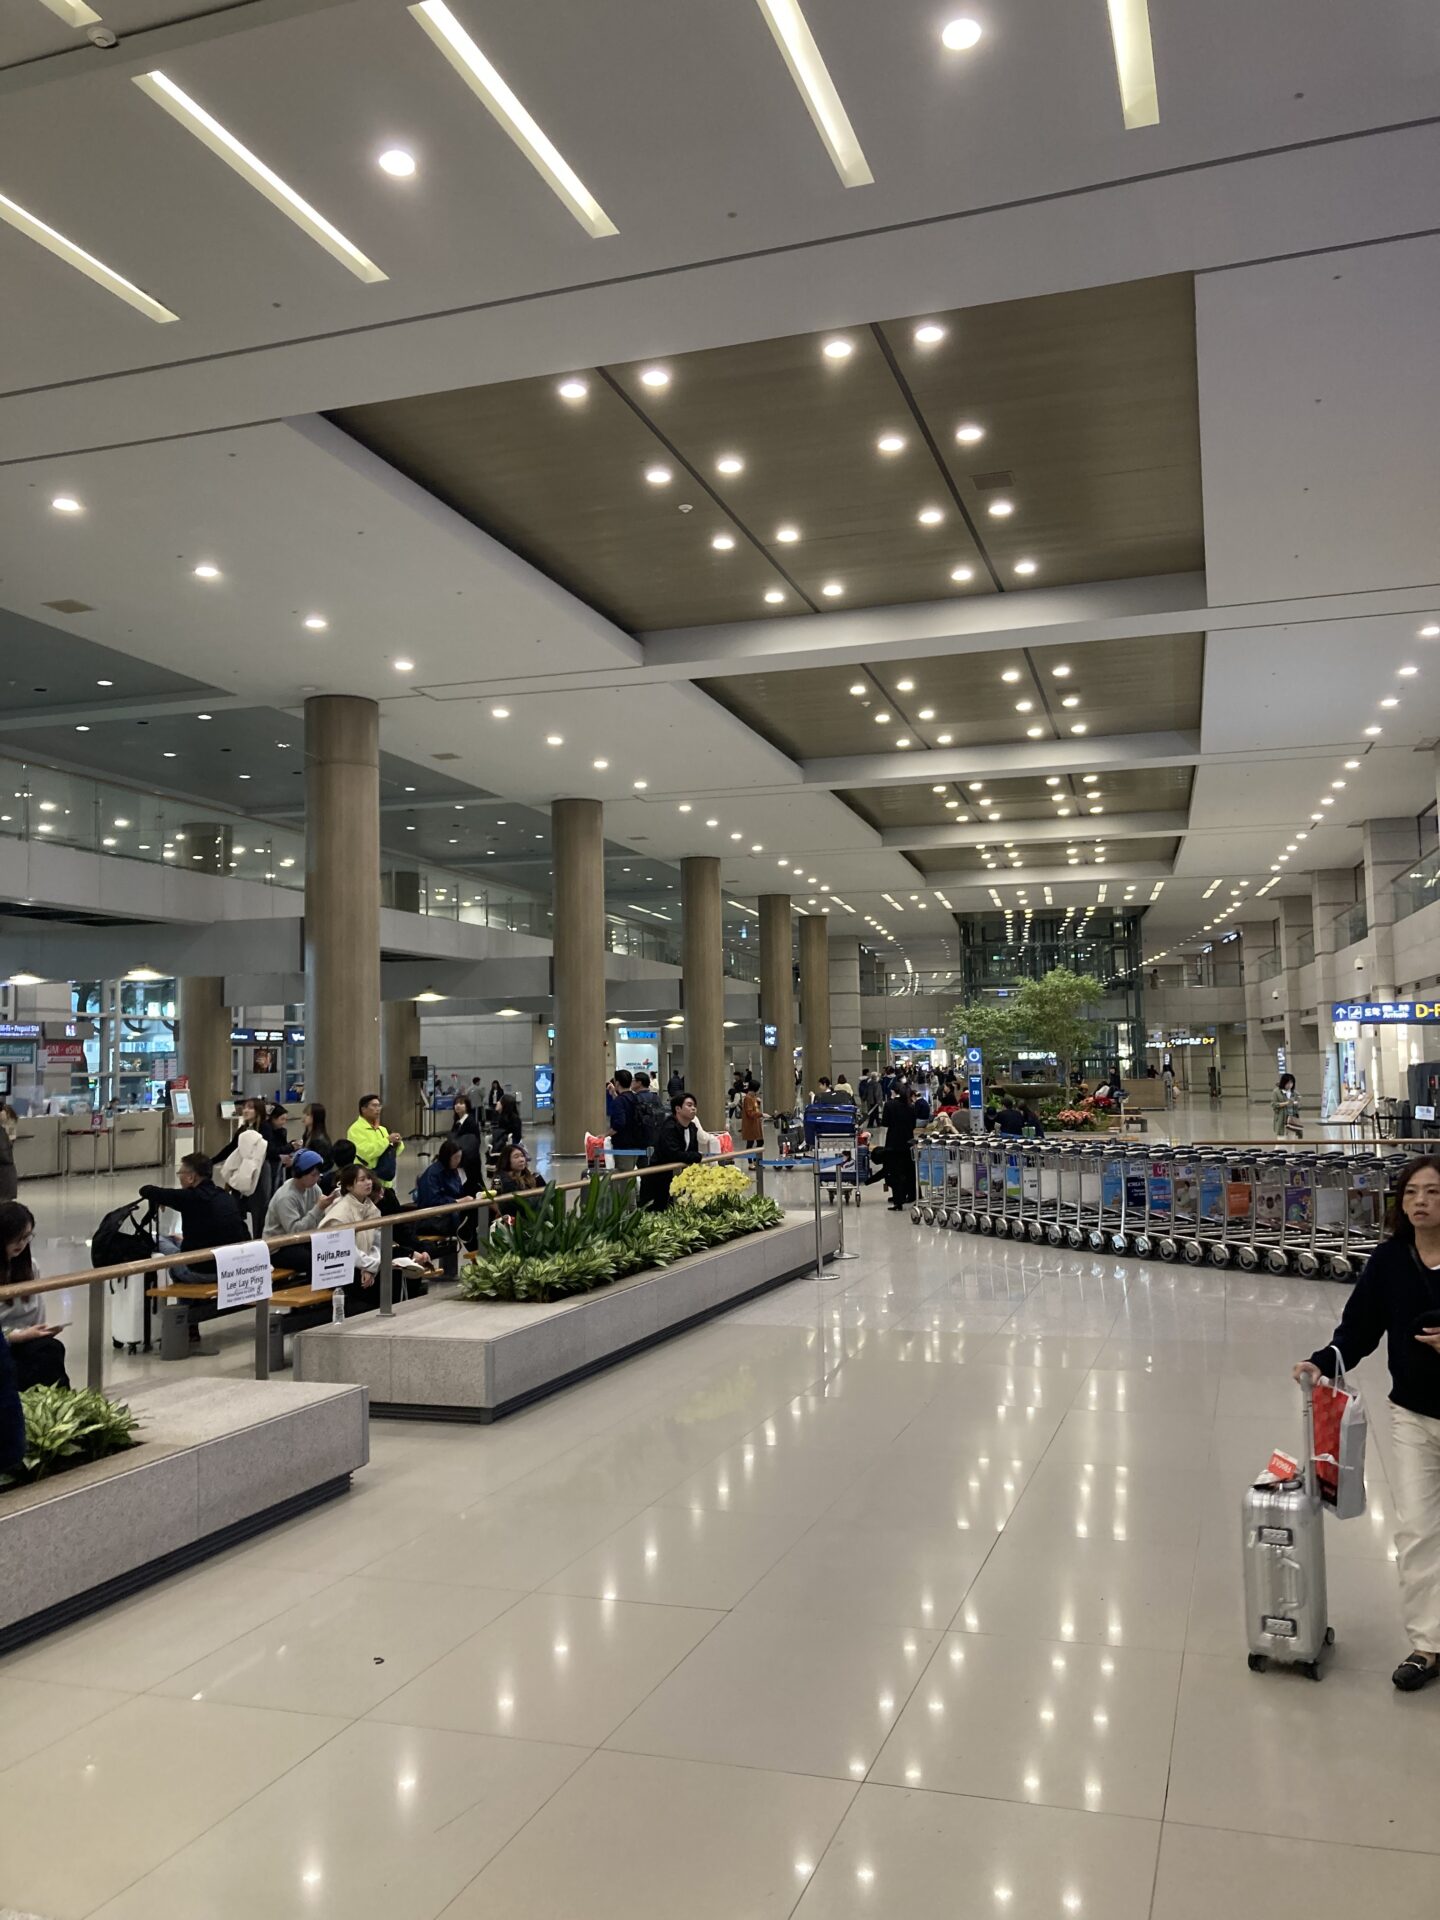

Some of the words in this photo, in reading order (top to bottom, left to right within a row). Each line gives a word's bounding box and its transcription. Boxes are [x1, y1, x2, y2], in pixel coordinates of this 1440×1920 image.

[221, 1271, 234, 1279] Max
[236, 1264, 268, 1276] Monestime
[226, 1282, 237, 1290] Lee
[238, 1280, 249, 1289] Lay
[250, 1276, 264, 1286] Ping
